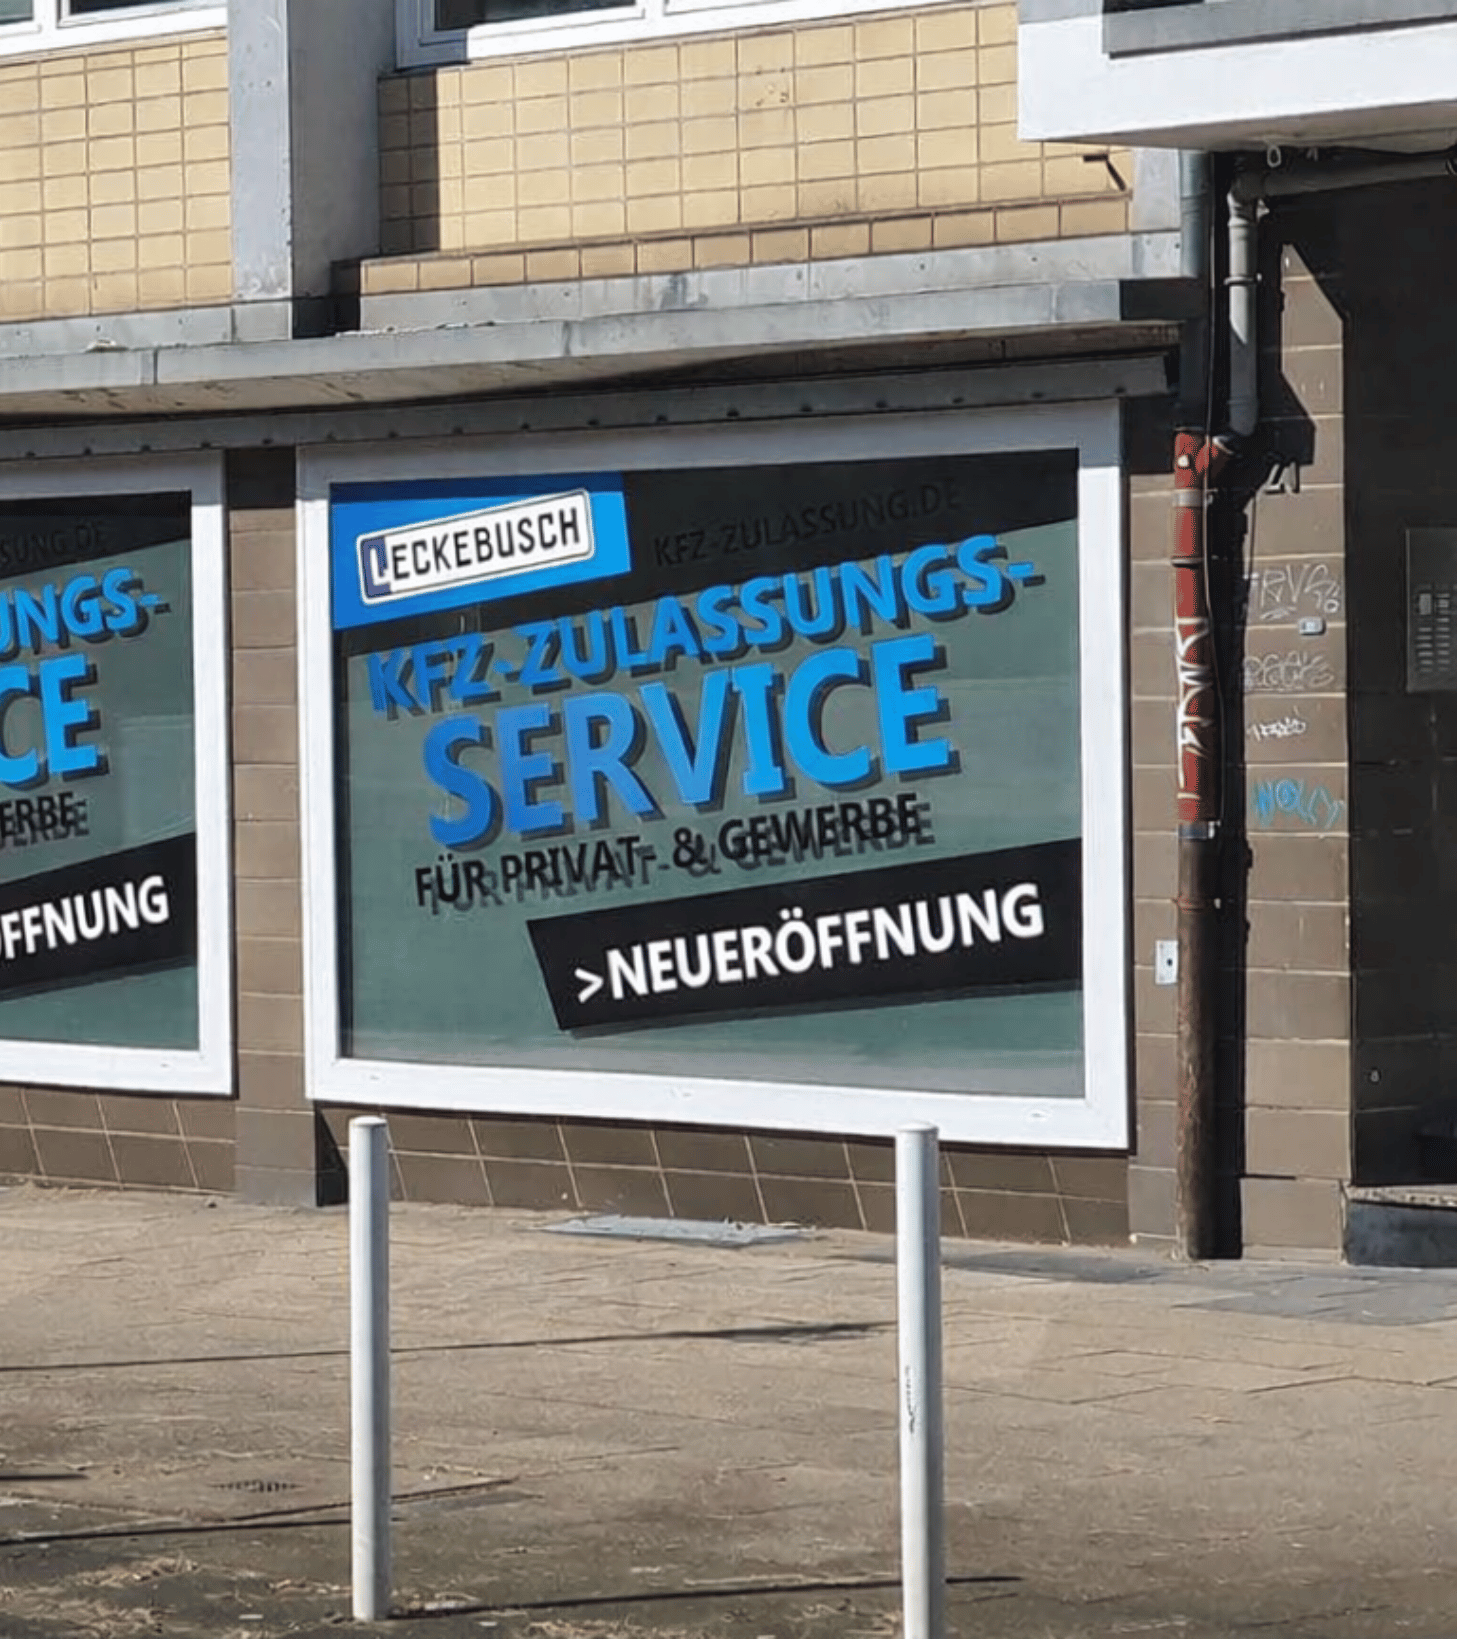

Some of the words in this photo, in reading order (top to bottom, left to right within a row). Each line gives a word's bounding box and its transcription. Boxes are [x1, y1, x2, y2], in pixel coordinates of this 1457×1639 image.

[368, 506, 581, 588] LECKEBUSCH
[368, 532, 1035, 713] KFZ-ZULASSUNGS-
[421, 633, 951, 848] SERVICE
[415, 854, 485, 906] FÜR
[501, 835, 657, 895] PRIVAT-
[672, 826, 701, 868] &
[718, 793, 919, 860] GEWERBE
